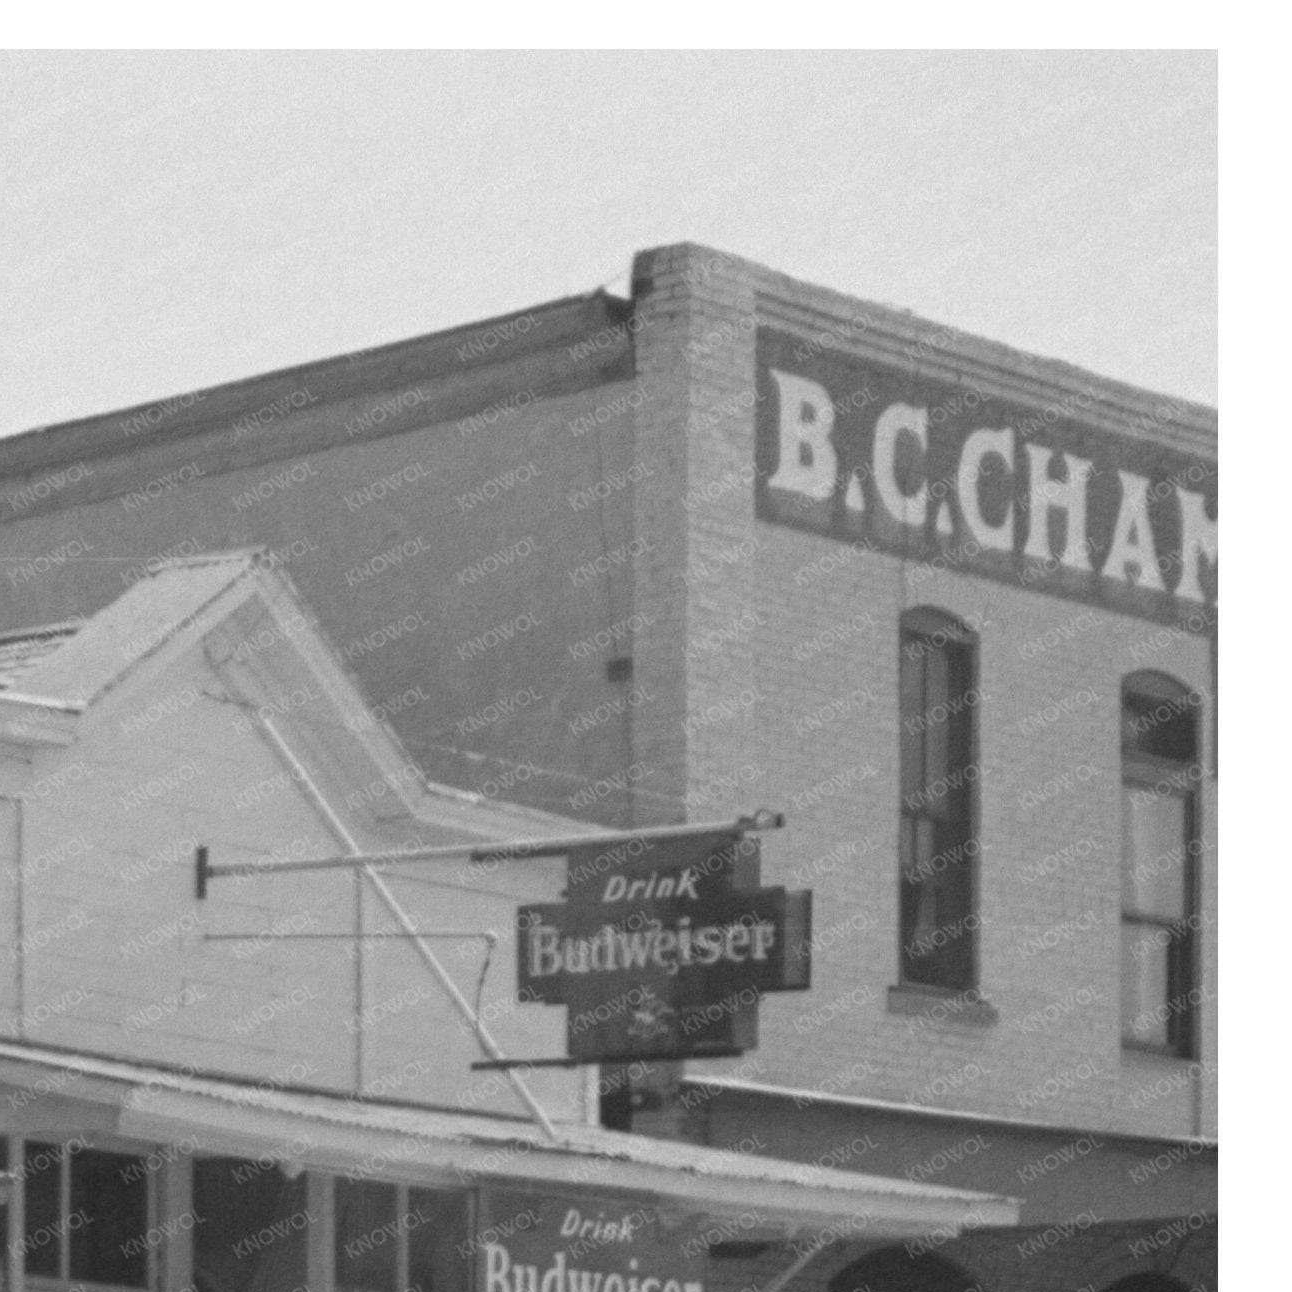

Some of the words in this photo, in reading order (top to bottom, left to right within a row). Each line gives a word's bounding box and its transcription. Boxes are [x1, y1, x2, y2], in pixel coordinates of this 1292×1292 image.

[602, 871, 701, 903] Drink
[527, 915, 777, 978] Budweiser
[560, 1207, 634, 1243] Drink
